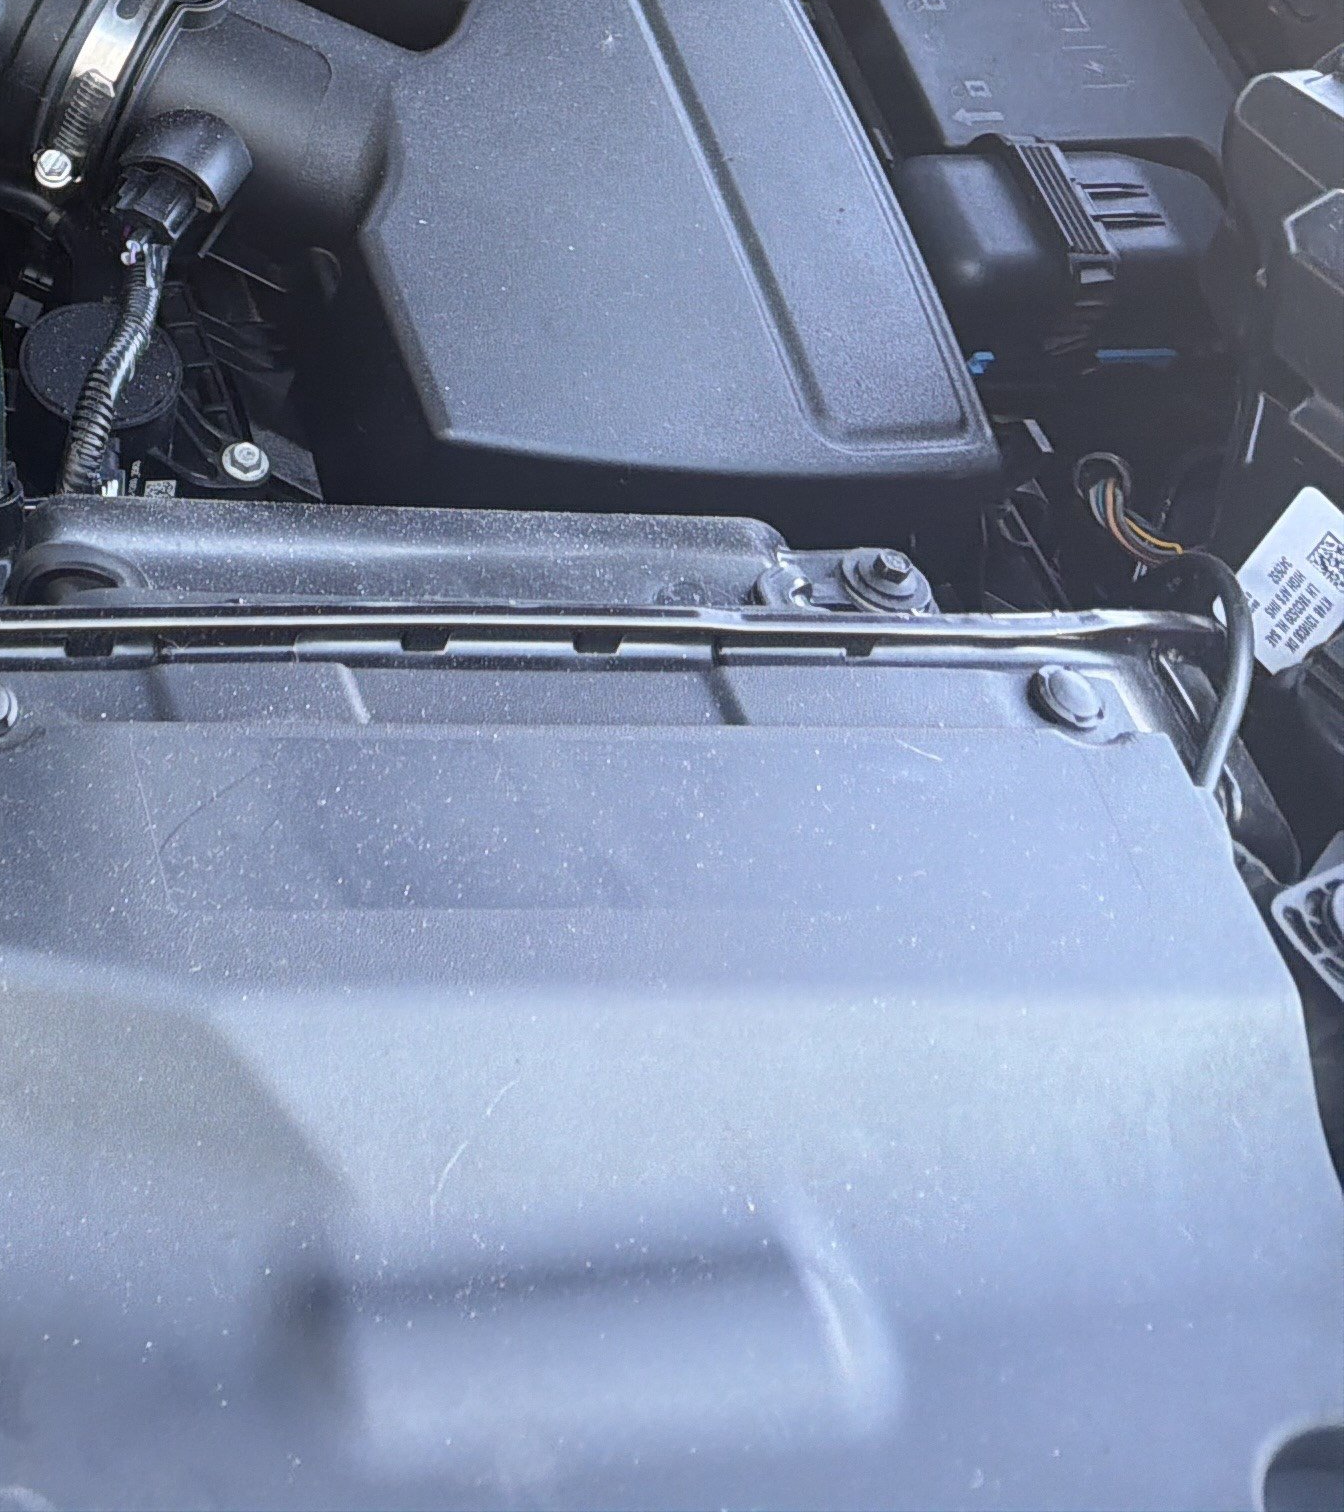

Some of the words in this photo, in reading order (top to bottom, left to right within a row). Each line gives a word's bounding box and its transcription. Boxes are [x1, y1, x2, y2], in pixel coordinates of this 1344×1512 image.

[1288, 569, 1307, 589] HIGH
[1306, 582, 1321, 598] LH
[1264, 628, 1283, 648] SAE
